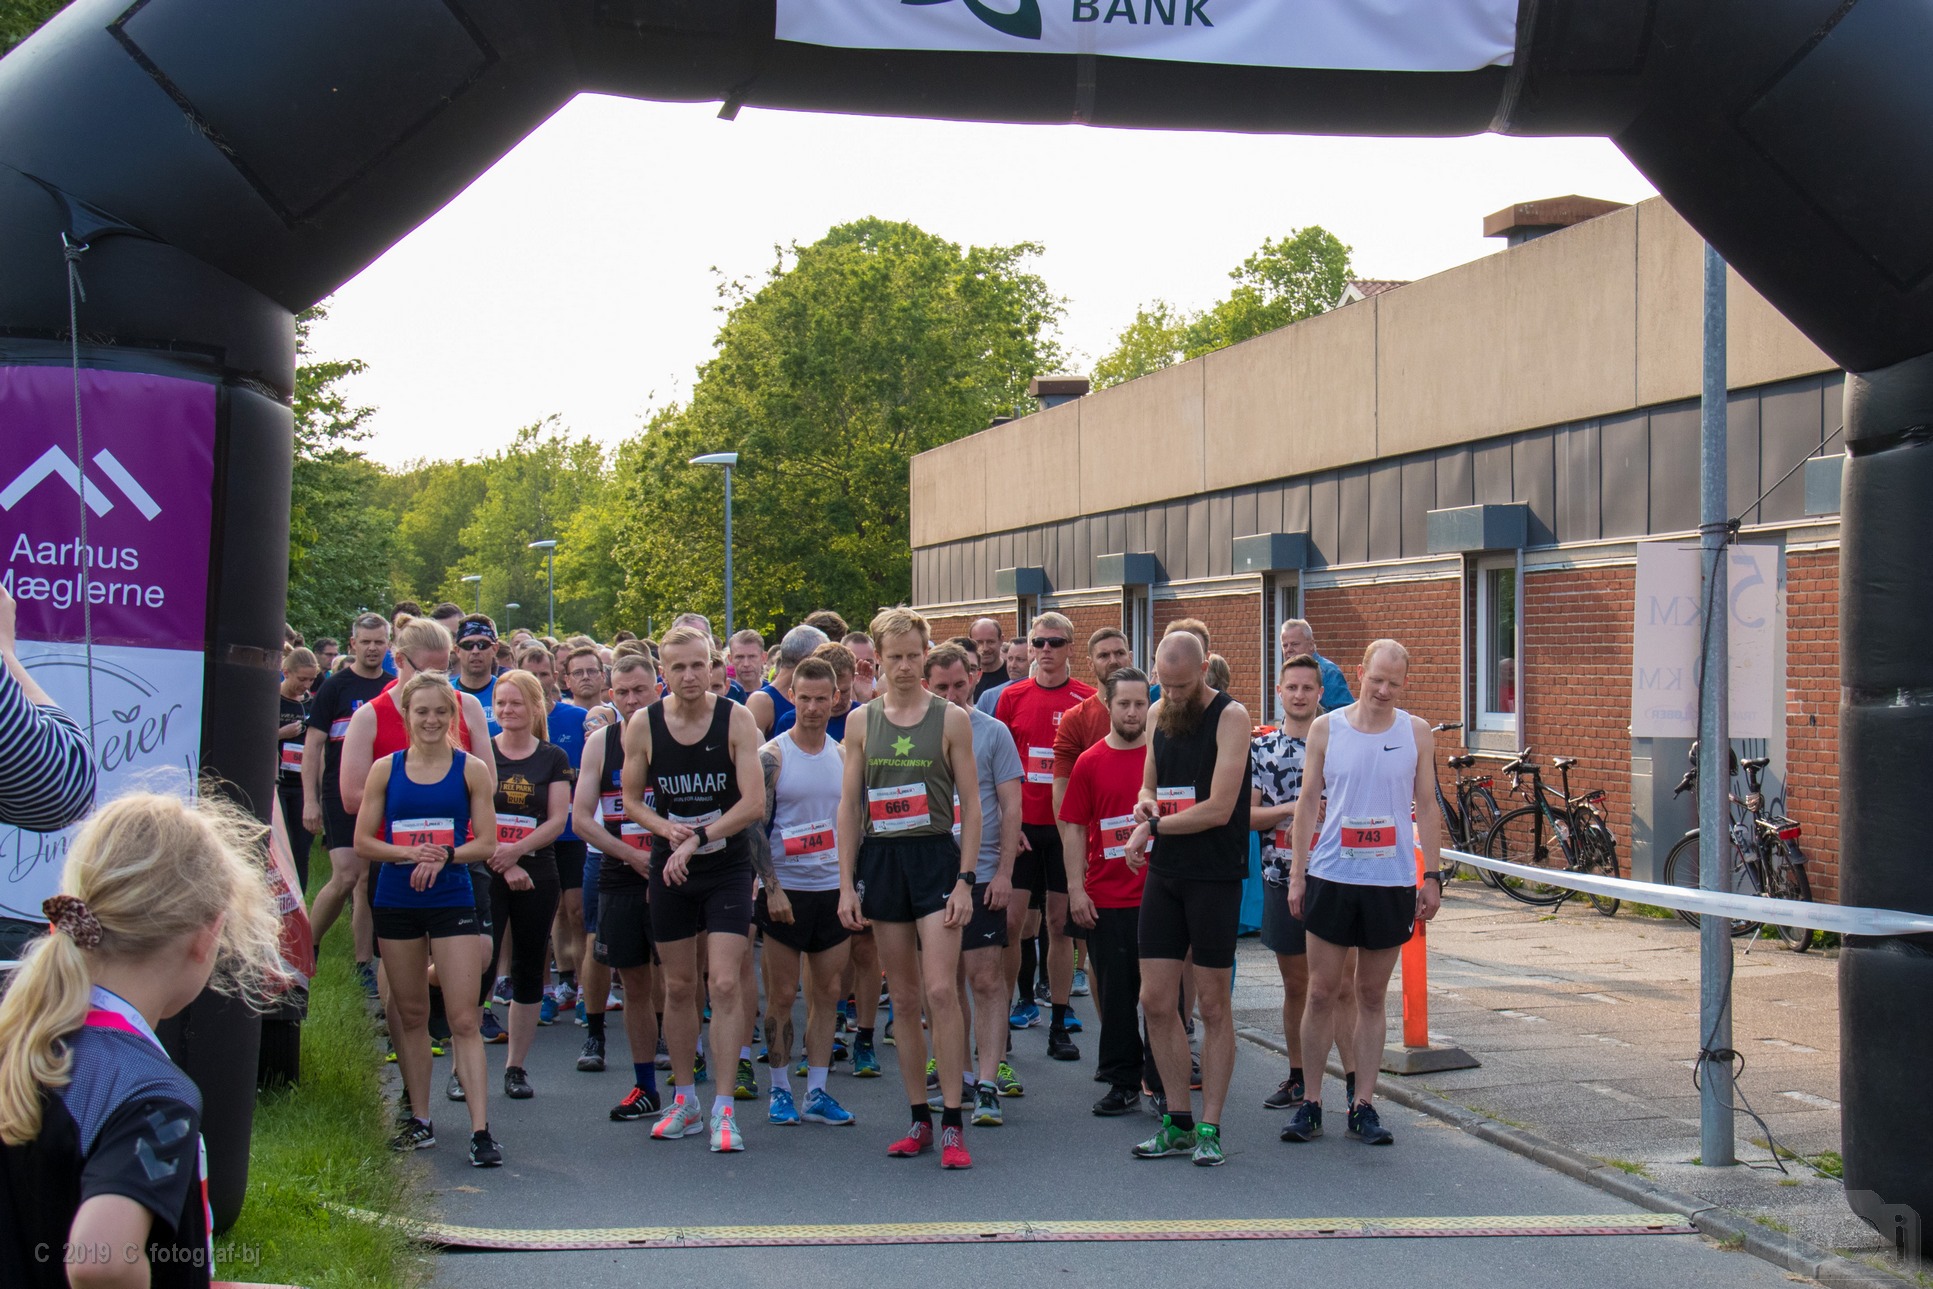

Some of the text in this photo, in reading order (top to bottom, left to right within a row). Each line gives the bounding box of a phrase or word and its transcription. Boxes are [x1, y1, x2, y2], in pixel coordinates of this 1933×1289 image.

[1072, 0, 1215, 28] BANK
[9, 533, 139, 571] Aarhus
[97, 704, 182, 772] eier
[1041, 760, 1055, 770] 57
[658, 773, 727, 795] RUNAAR
[508, 796, 525, 805] RUN
[885, 799, 910, 815] 666
[1161, 802, 1178, 814] 671
[409, 832, 434, 846] 741
[501, 826, 523, 839] 672
[1356, 830, 1381, 843] 743
[637, 835, 653, 848] 70
[800, 834, 823, 849] 744
[0, 826, 70, 883] Din
